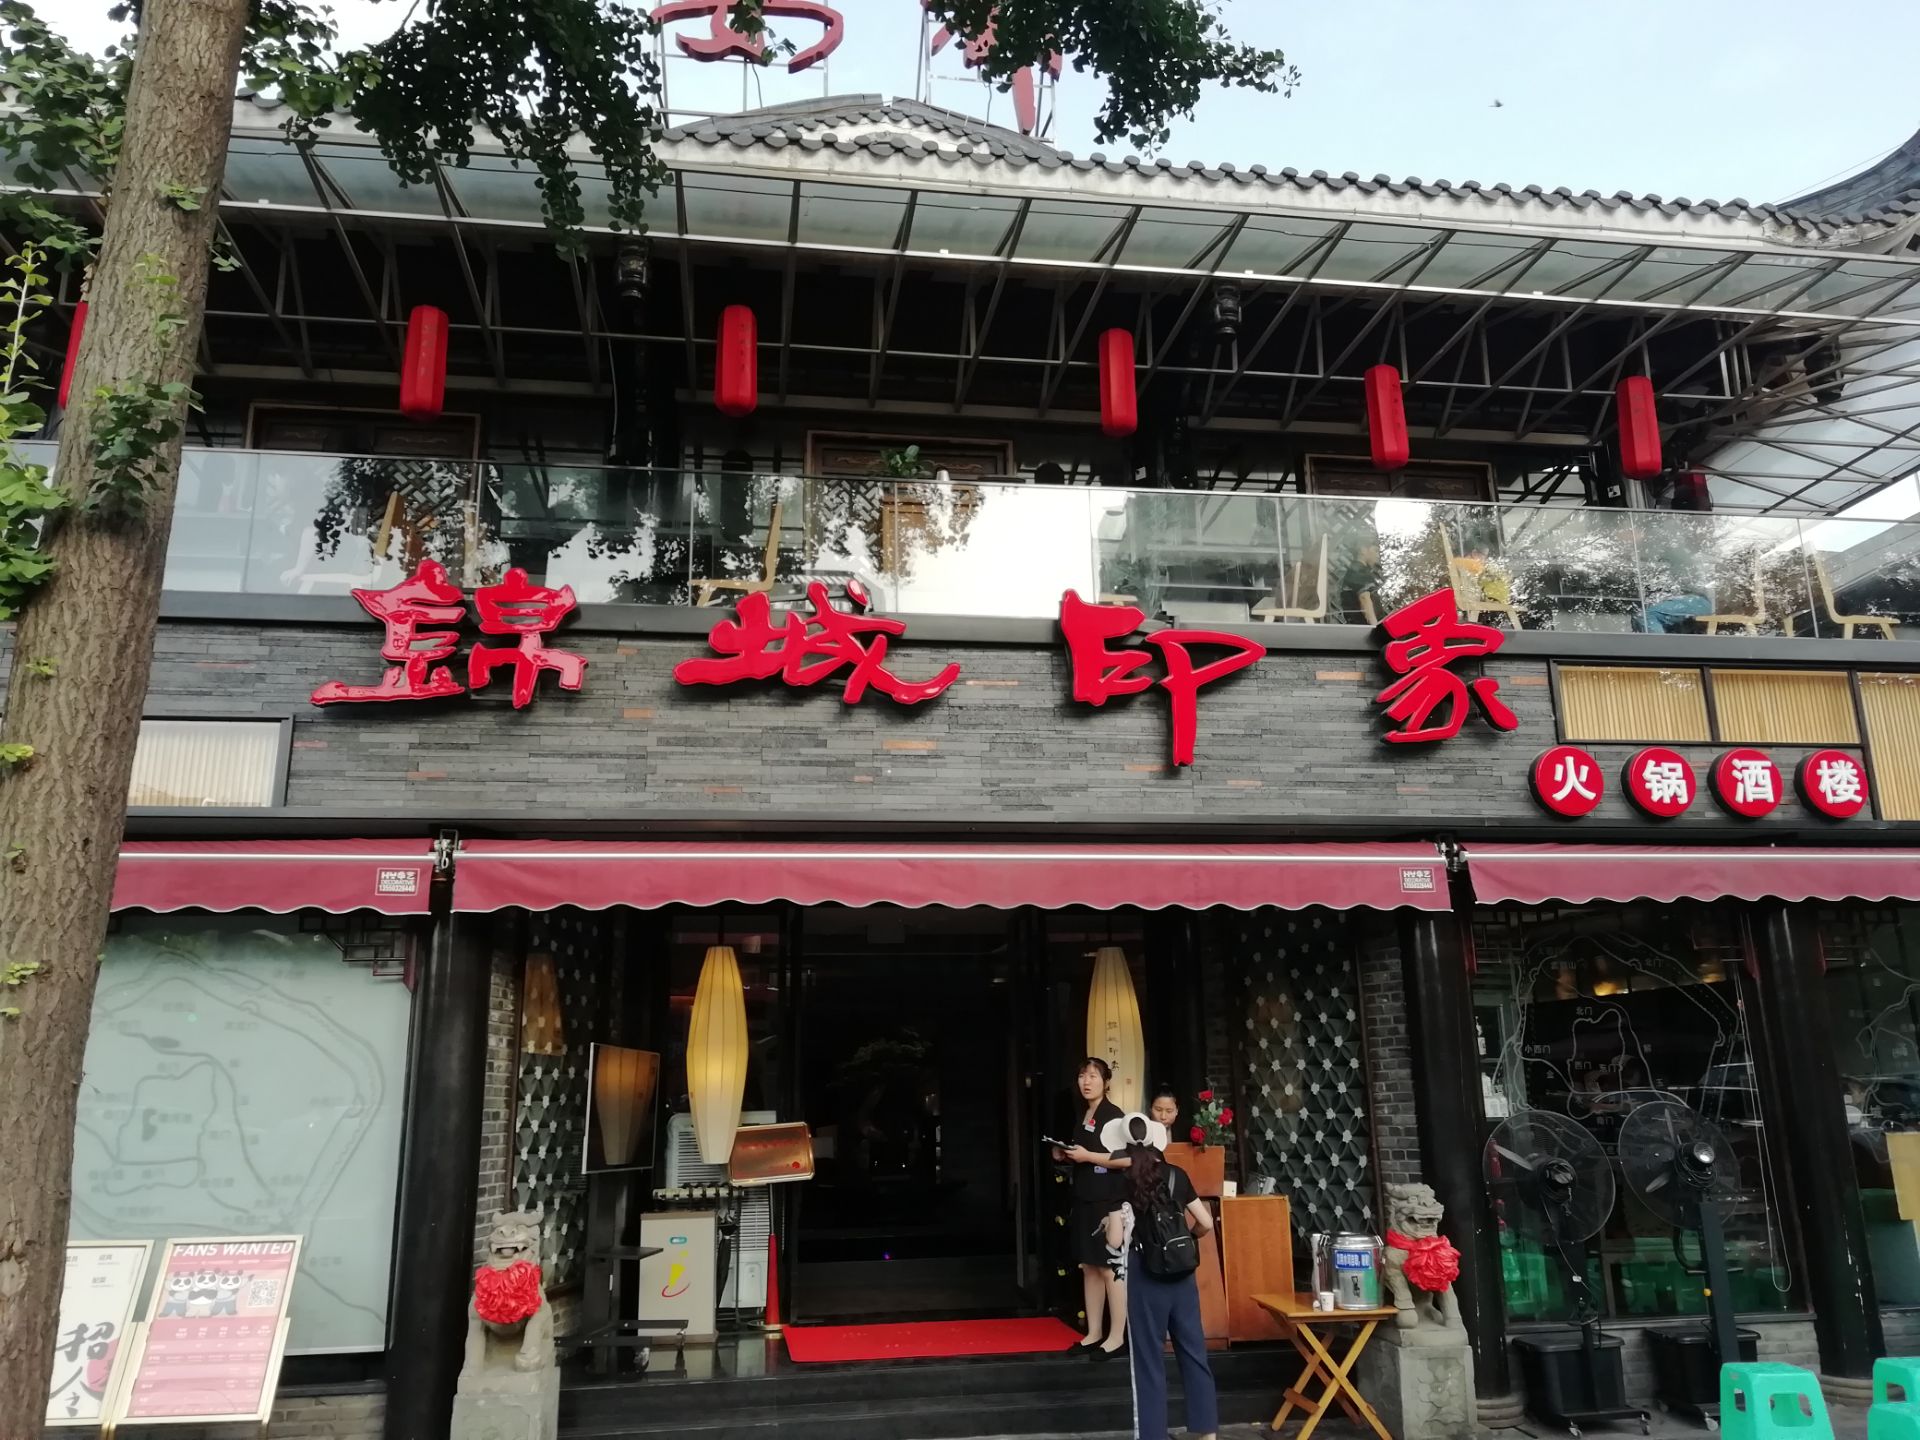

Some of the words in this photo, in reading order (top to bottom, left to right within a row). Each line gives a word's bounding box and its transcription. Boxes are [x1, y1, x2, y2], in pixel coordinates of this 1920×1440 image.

[1552, 755, 1863, 805] 火锅酒楼
[173, 1244, 218, 1257] FANS
[222, 1241, 294, 1256] WANTED
